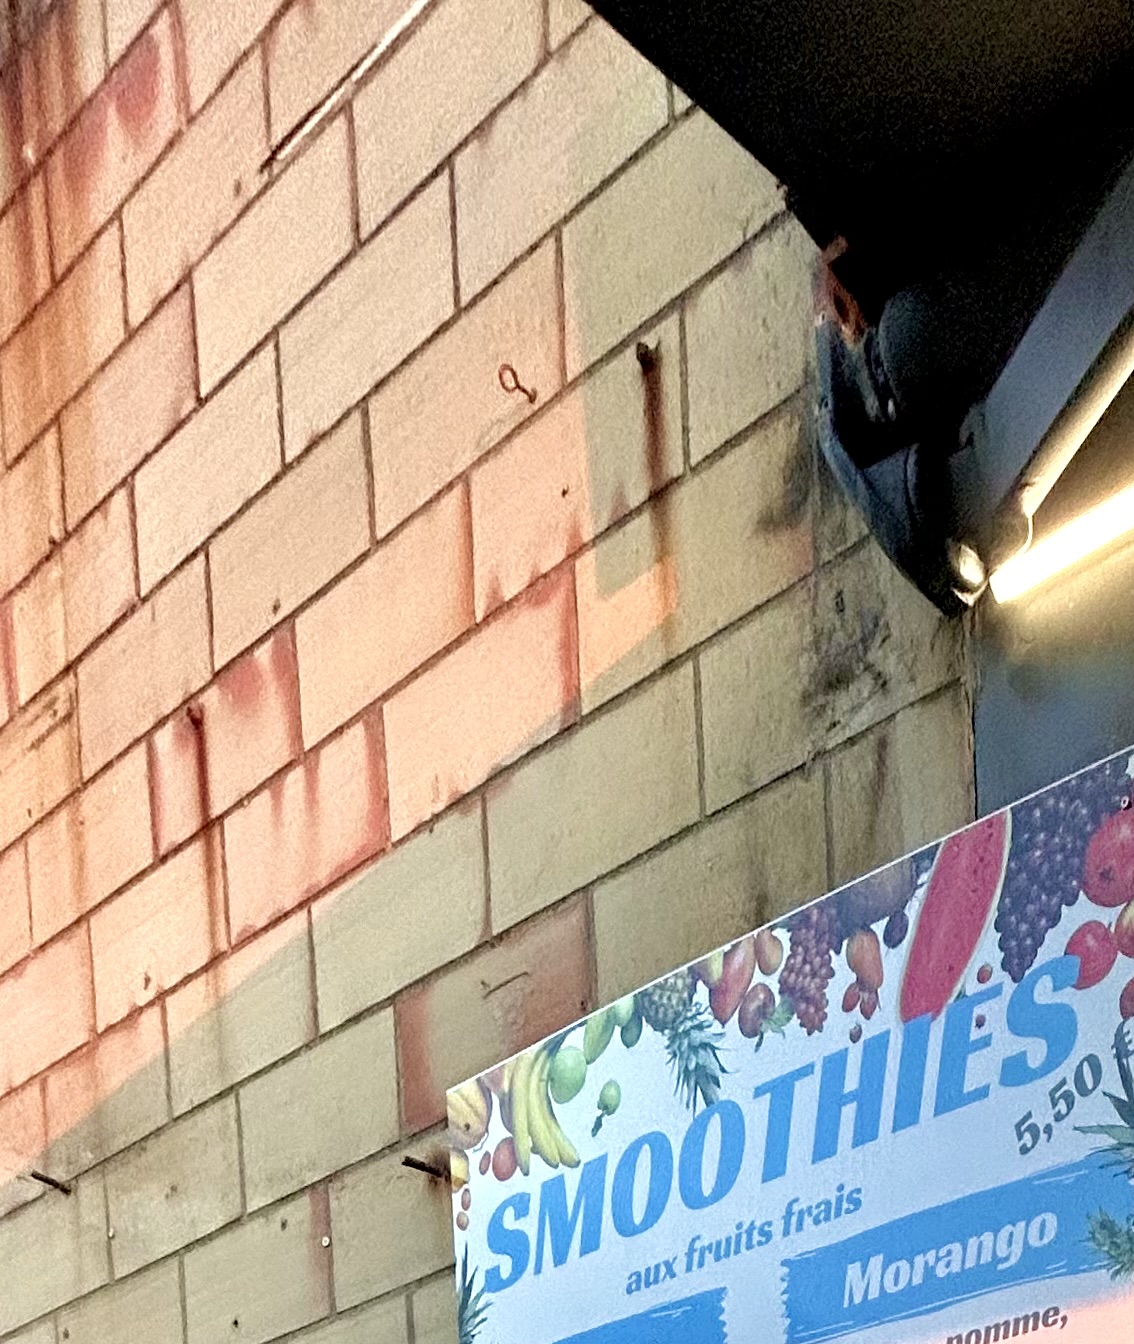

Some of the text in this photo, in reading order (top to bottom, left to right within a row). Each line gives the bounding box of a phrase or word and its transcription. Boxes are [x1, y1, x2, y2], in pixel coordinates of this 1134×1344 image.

[481, 954, 1080, 1292] SMOOTHIES
[1014, 1053, 1102, 1155] 5,50
[626, 1183, 864, 1294] aux fruits frais
[842, 1208, 1059, 1310] Morango
